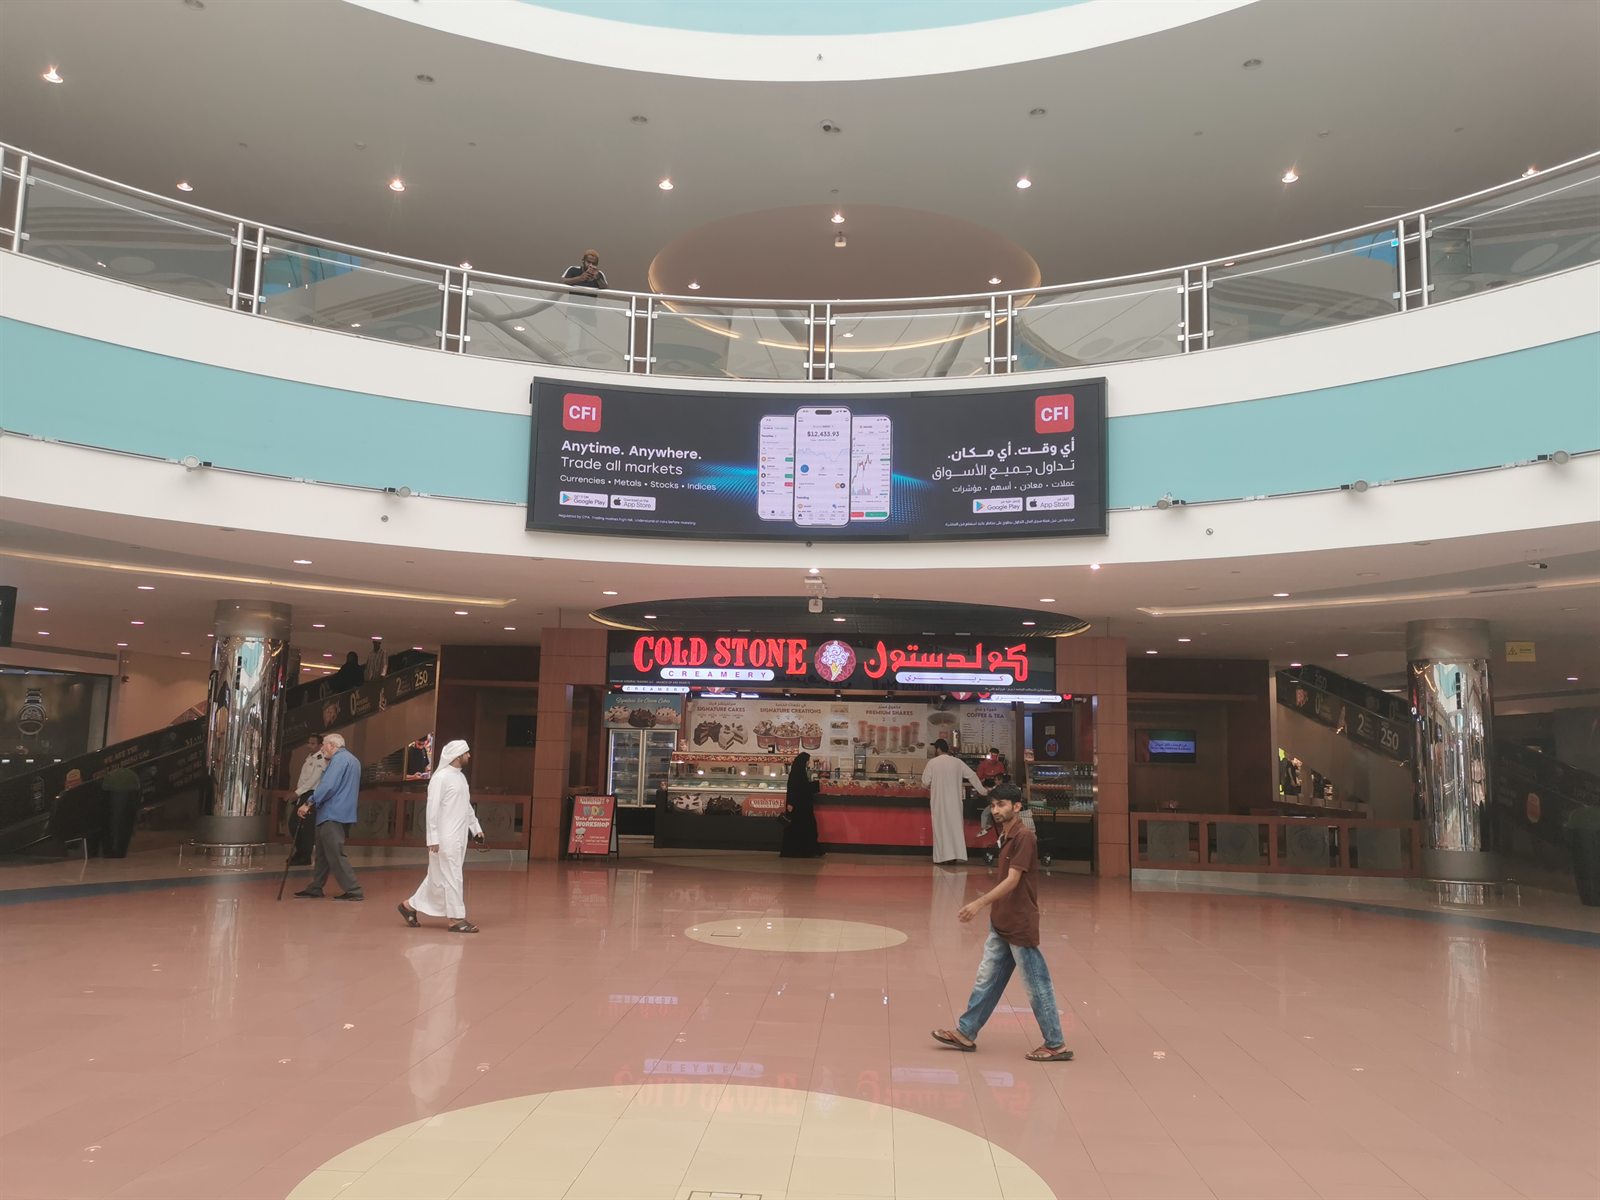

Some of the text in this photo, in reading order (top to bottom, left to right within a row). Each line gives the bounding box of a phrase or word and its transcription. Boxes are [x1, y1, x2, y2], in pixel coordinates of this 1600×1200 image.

[568, 405, 596, 420] CFI
[1040, 406, 1068, 422] CFI
[561, 440, 702, 461] Anytime. Anywhere.
[997, 441, 1012, 462] أي
[1060, 437, 1075, 456] أي
[561, 456, 682, 475] Trade all markets
[989, 463, 1032, 480] جميع
[1035, 460, 1075, 475] تداول
[560, 474, 716, 491] Currencies Metals Stocks Indices
[633, 636, 807, 674] COLD STONE
[414, 670, 428, 687] 250
[668, 670, 767, 679] CREAMERY
[1380, 727, 1399, 750] 250
